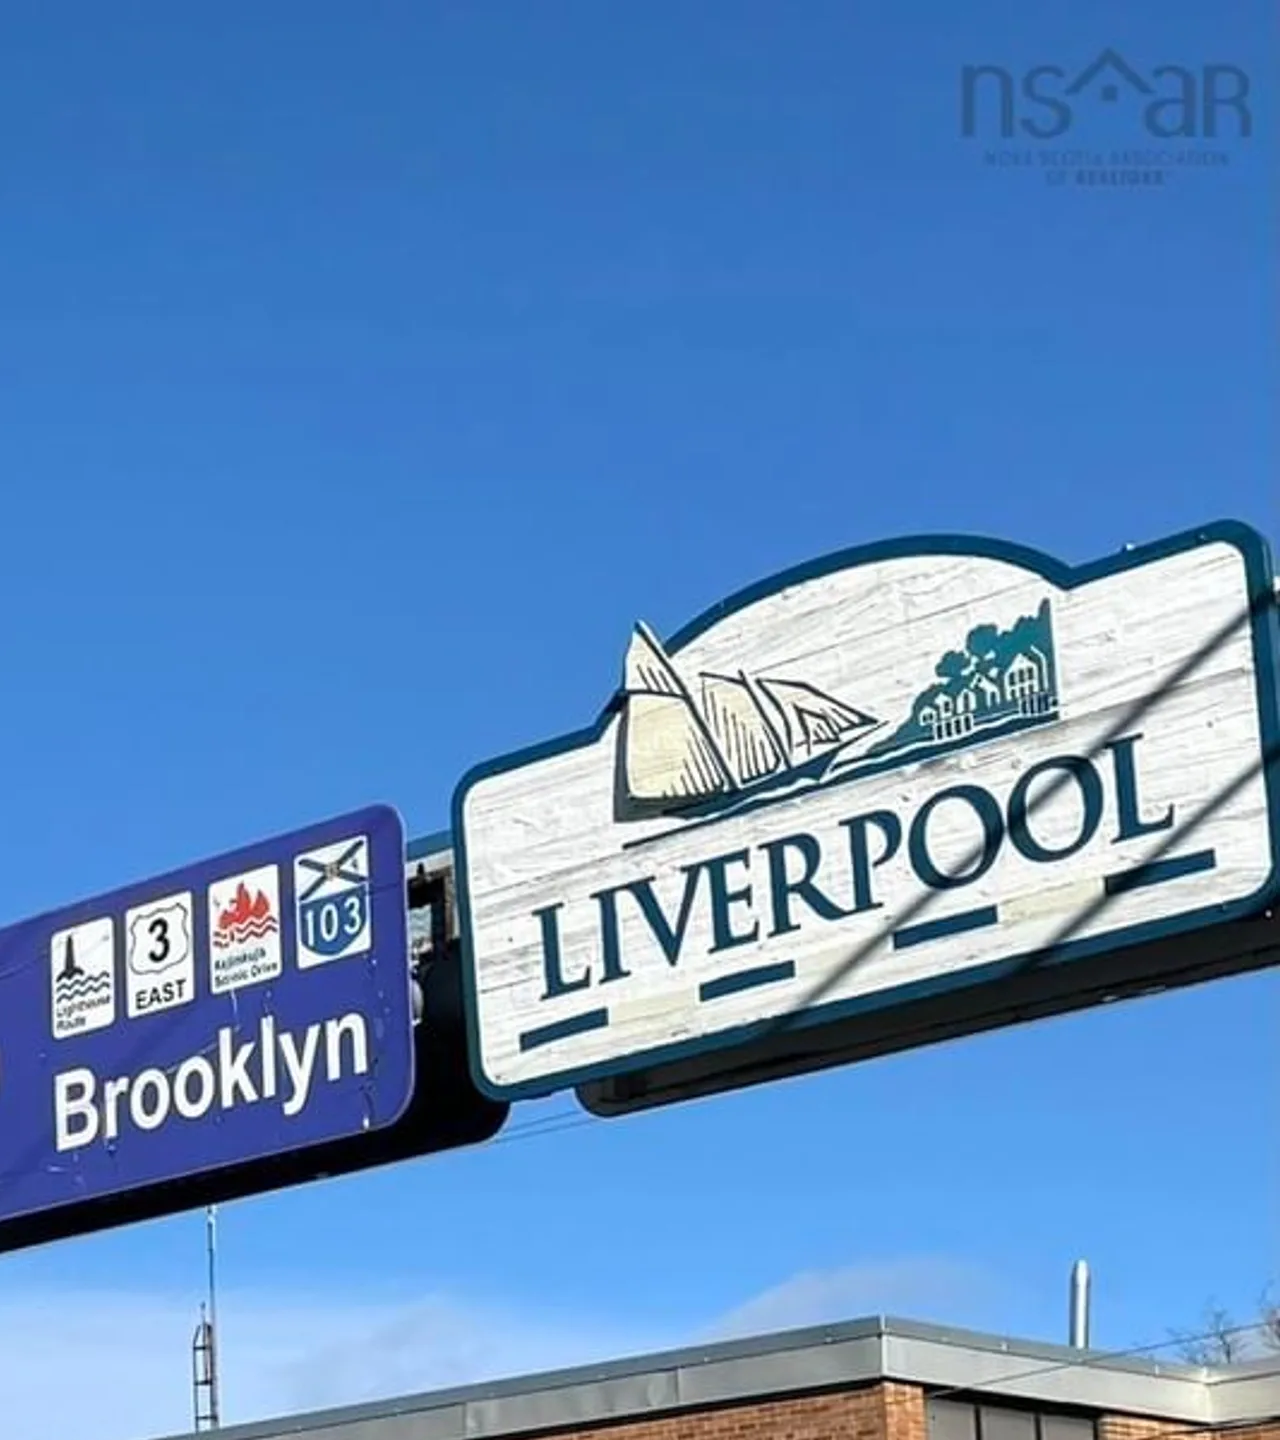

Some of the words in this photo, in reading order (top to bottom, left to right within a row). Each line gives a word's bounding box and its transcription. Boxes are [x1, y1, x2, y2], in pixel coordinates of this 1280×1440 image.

[532, 734, 1174, 1000] LIVERPOOL
[148, 917, 170, 963] 3
[305, 896, 362, 948] 103
[135, 979, 187, 1010] EAST
[54, 1012, 368, 1152] Brooklyn
